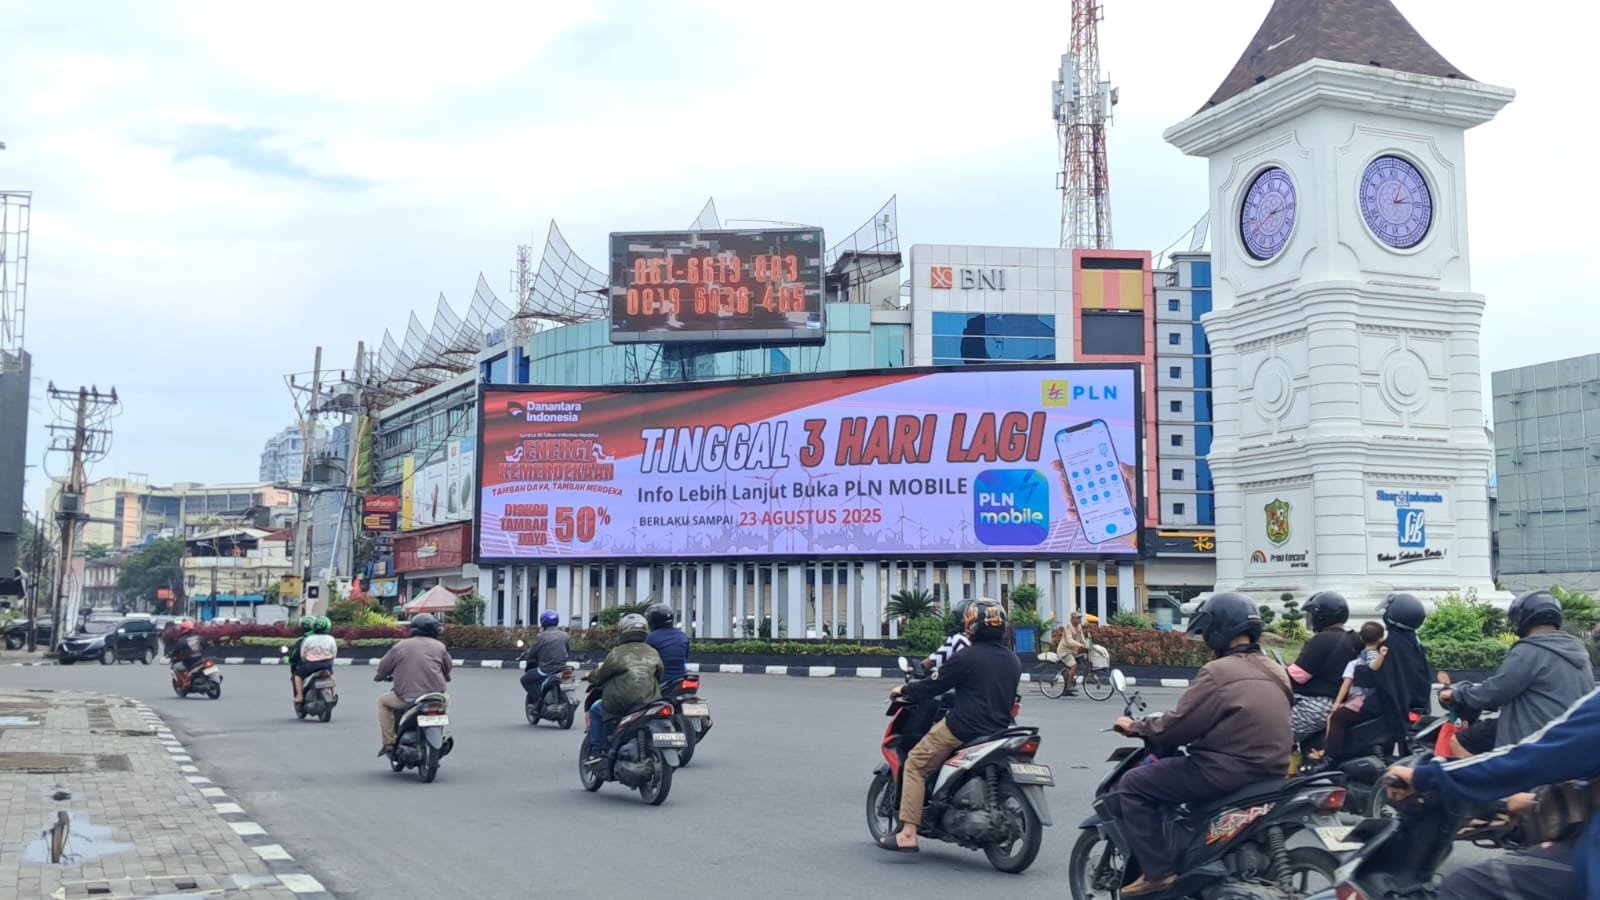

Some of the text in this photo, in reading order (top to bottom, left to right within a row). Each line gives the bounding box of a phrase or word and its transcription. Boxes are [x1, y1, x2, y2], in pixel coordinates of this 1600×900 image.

[960, 268, 1006, 291] BNI
[1073, 385, 1118, 401] PLN
[526, 401, 582, 411] Danantara
[526, 412, 578, 422] Indonesia
[523, 439, 593, 462] ENERGI
[640, 411, 1047, 474] TINGGAL 3 HARI LAGI
[498, 463, 615, 481] KEMERDEKAAN
[492, 483, 623, 497] TAMBAH DAYA, TAMBAH MERDEKA
[638, 478, 967, 504] Info Lebih Lanjut Buka PLN MOBILE
[979, 491, 1015, 507] PLN
[504, 503, 549, 517] DISKON
[639, 508, 882, 528] BERLAKU SAMPAI 23 AGUSTUS 2025
[980, 508, 1044, 525] mobile
[500, 518, 548, 531] TAMBAH
[554, 505, 611, 543] 50%
[517, 532, 548, 545] DAYA
